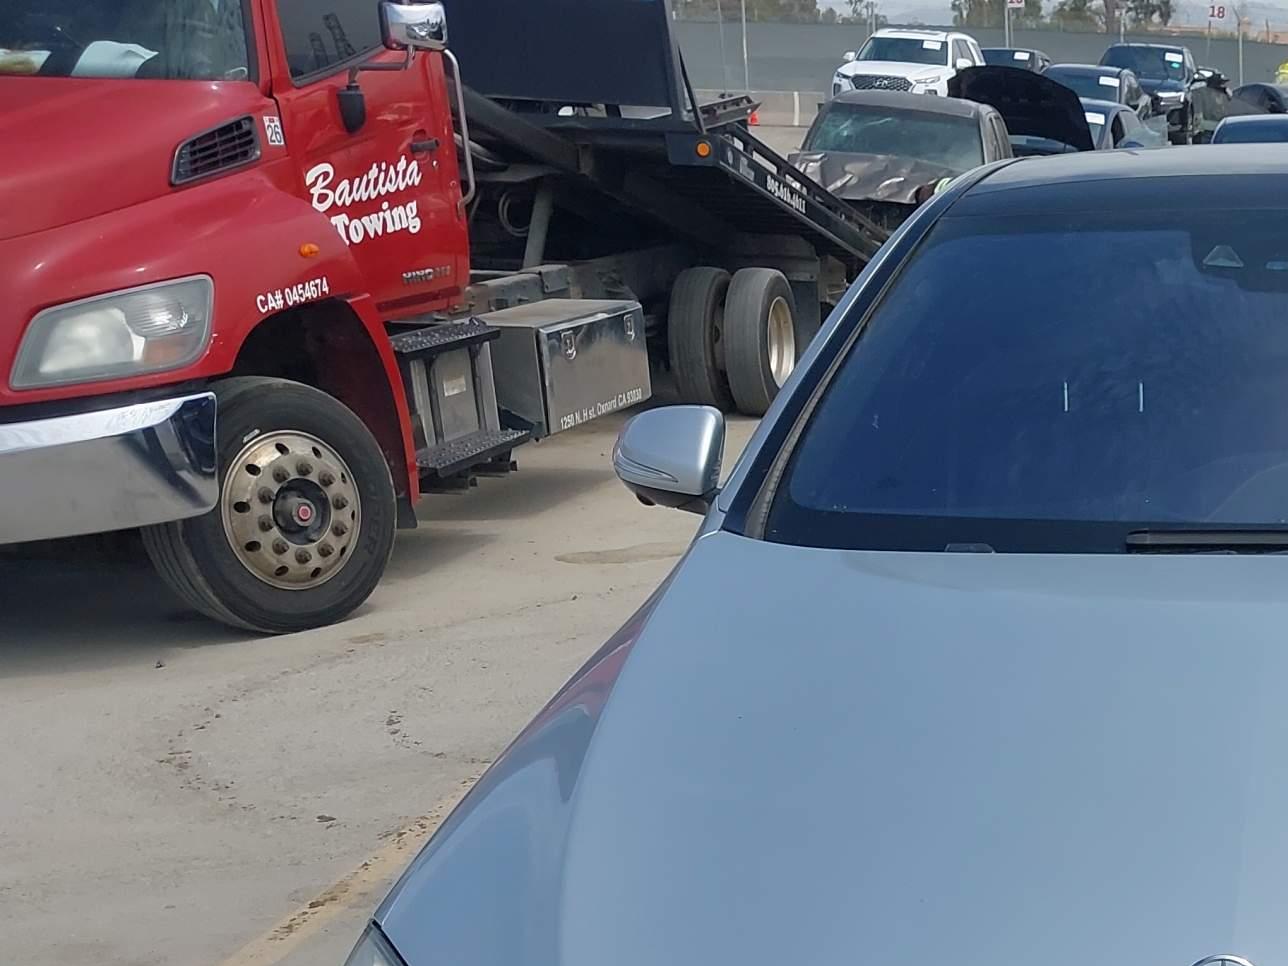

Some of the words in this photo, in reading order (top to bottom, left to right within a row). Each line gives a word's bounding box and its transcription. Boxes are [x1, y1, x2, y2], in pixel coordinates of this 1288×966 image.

[1208, 5, 1225, 19] 18
[266, 124, 282, 144] 26
[304, 154, 422, 213] Bautista
[330, 200, 422, 246] Towing
[256, 289, 284, 313] CA#
[285, 276, 329, 306] 0454674
[560, 413, 575, 430] 1250
[582, 408, 589, 422] H
[597, 395, 617, 415] Oxnard
[618, 393, 627, 407] CA
